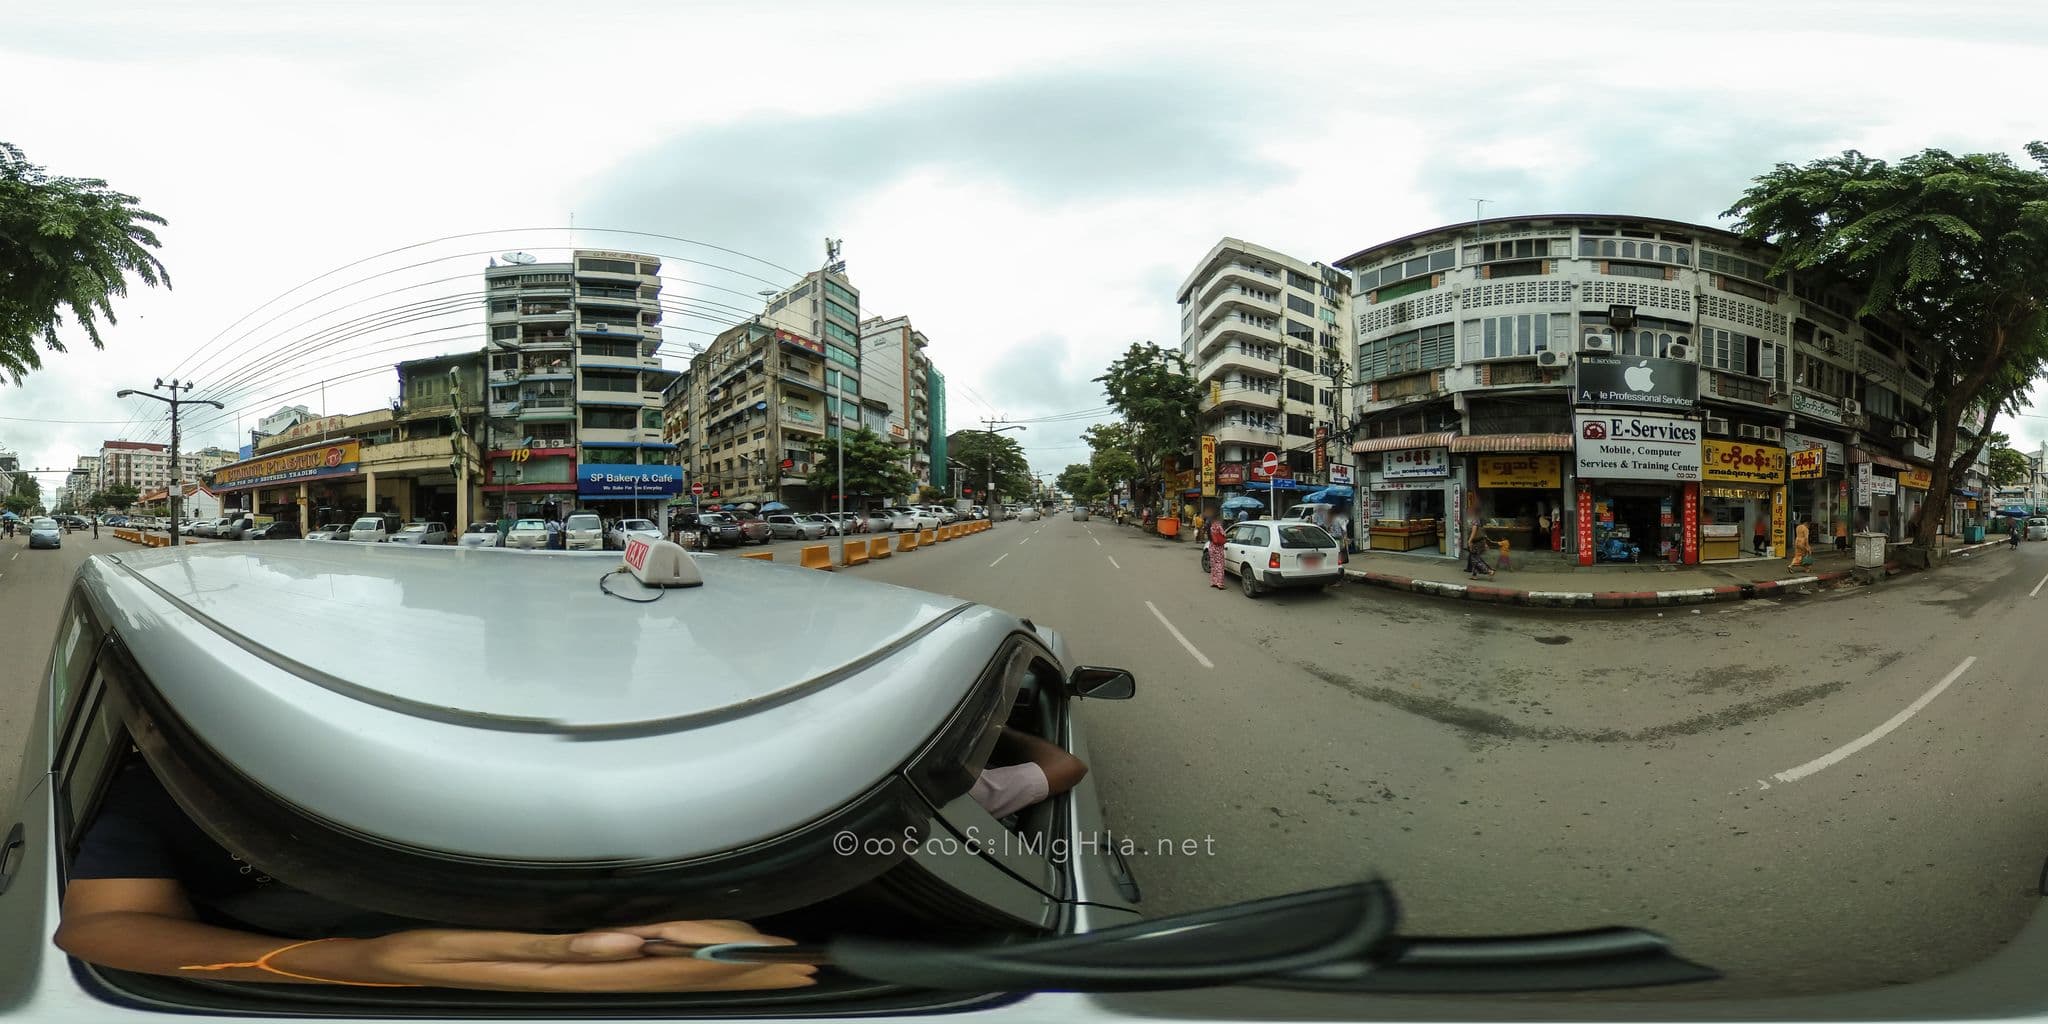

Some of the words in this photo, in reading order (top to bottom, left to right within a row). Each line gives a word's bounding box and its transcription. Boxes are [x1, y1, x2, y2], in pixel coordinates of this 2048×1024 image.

[1582, 390, 1608, 400] Ale
[1609, 391, 1662, 403] Professional
[1610, 418, 1697, 441] E-Services
[510, 449, 530, 462] 119
[1600, 445, 1635, 455] Mobile,
[1637, 446, 1682, 457] Computer
[266, 452, 321, 473] PLASTIC
[1580, 459, 1618, 469] Services
[1620, 460, 1629, 469] &
[1631, 460, 1669, 472] Training
[1671, 462, 1699, 472] Center
[289, 469, 318, 479] TRADING
[590, 473, 604, 483] SP
[606, 473, 640, 484] Bakery
[642, 473, 650, 483] &
[651, 473, 673, 483] Café
[626, 540, 649, 570] TAXI
